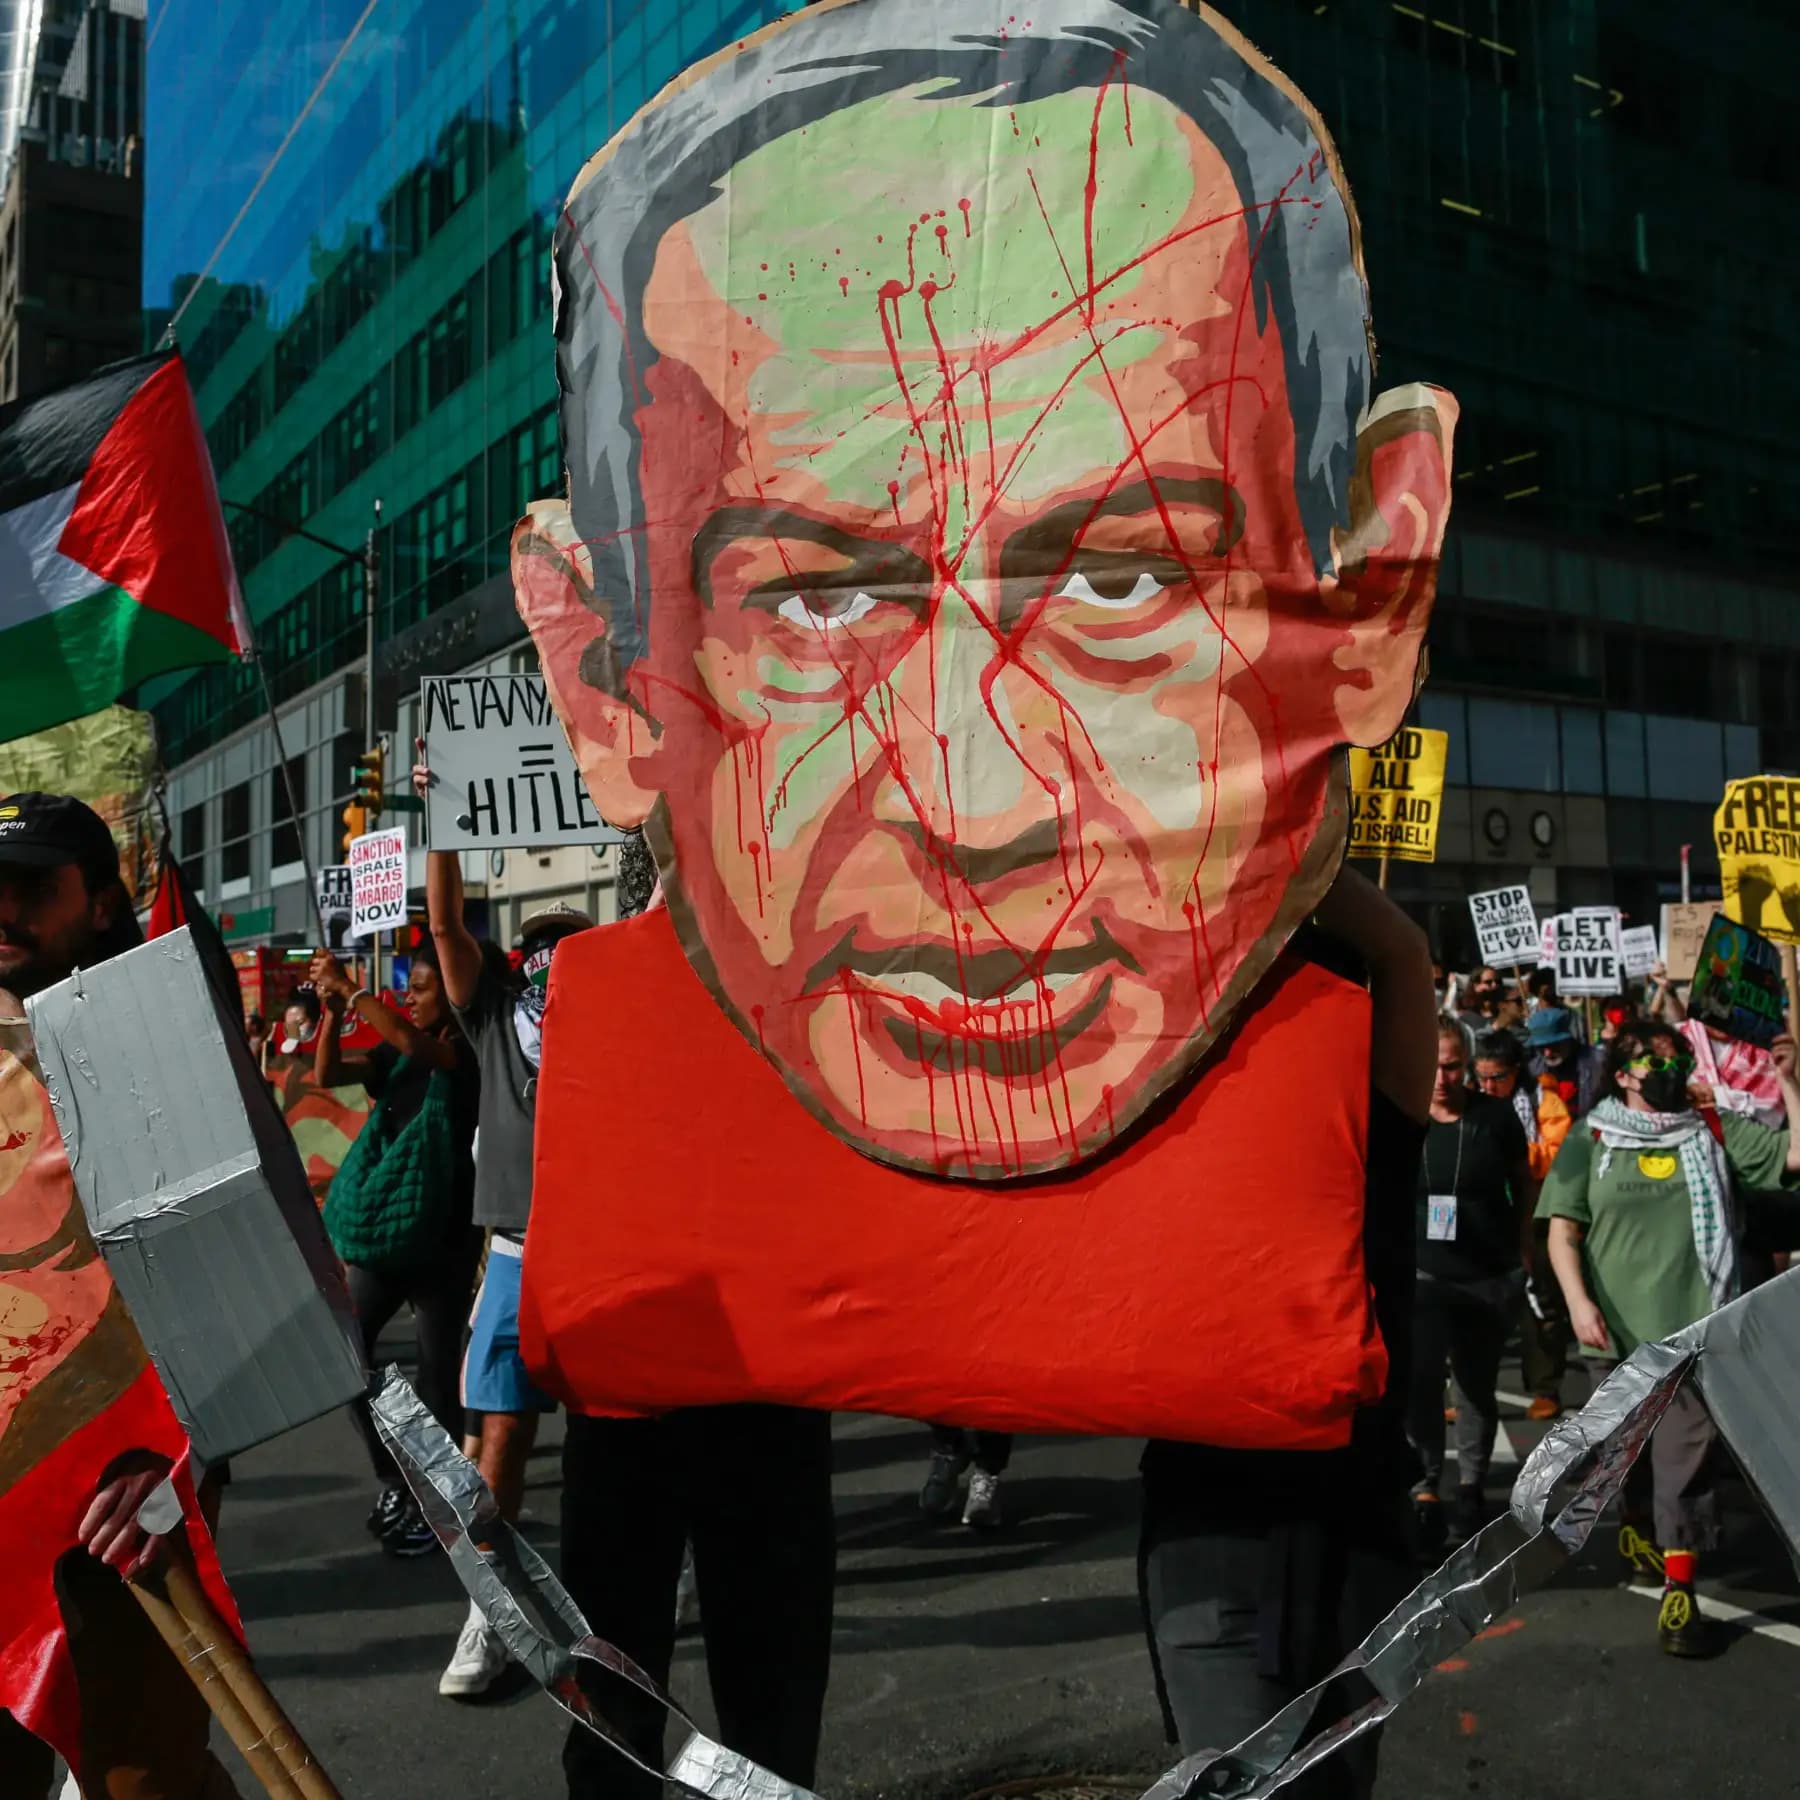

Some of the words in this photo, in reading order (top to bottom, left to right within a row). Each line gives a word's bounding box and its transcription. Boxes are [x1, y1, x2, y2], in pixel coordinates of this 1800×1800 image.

[1368, 761, 1414, 790] ALL
[468, 769, 609, 836] HITLE
[1394, 797, 1431, 824] AID
[1724, 781, 1800, 831] FREE
[0, 821, 26, 830] pen
[1352, 823, 1362, 841] O
[1367, 824, 1429, 846] ISRAEL!
[352, 838, 402, 865] SANCTION
[1719, 831, 1800, 859] PALESTIN
[353, 857, 402, 877] ISRAEL
[355, 868, 402, 888] ARMS
[323, 869, 352, 893] FR
[320, 894, 352, 908] PALE
[355, 883, 403, 908] EMBARGO
[1474, 890, 1524, 912] STOP
[355, 900, 402, 925] NOW
[1477, 905, 1529, 923] KILLING
[1482, 931, 1500, 943] LET
[1504, 925, 1534, 938] GAZA
[1558, 917, 1611, 936] LET
[1484, 936, 1537, 954] LIVE
[1558, 938, 1612, 951] GAZA
[1560, 957, 1615, 978] LIVE
